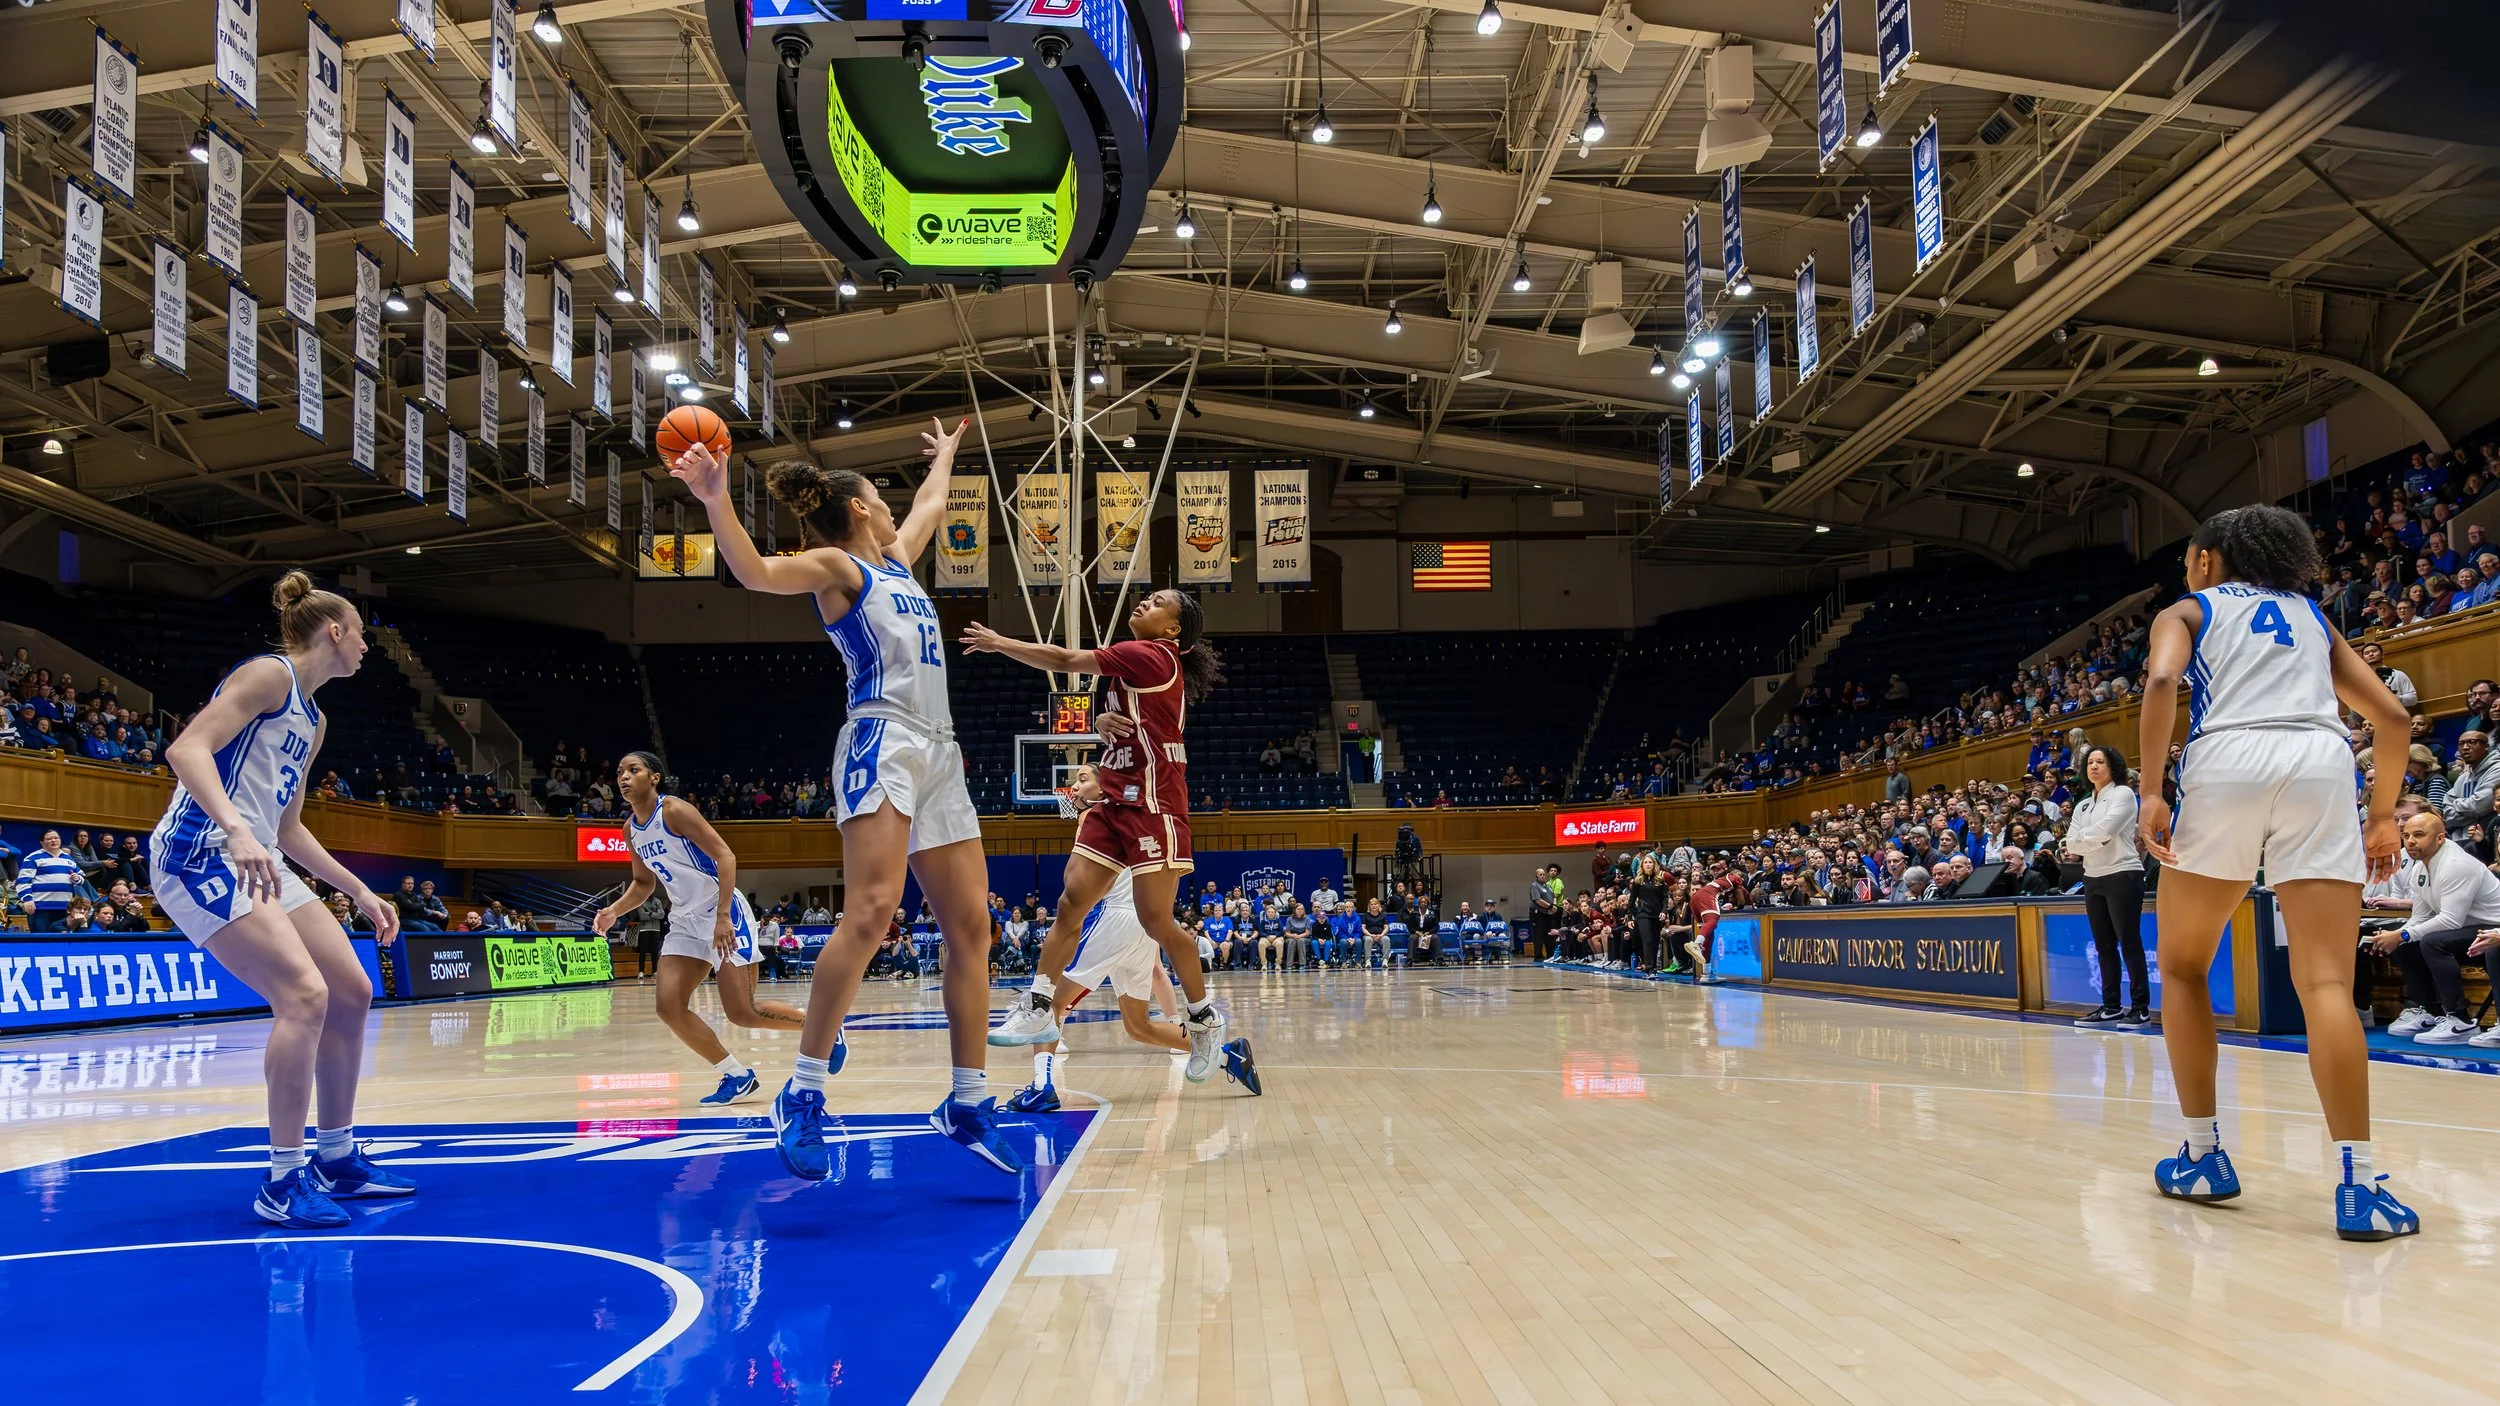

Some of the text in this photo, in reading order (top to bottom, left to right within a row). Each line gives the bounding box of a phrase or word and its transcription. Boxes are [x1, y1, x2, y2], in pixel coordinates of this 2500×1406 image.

[1891, 3, 1906, 27] FOUR
[230, 19, 248, 41] NCAA
[219, 29, 239, 53] FINAL
[229, 69, 247, 90] 1988
[103, 95, 129, 121] ATLANTIC
[318, 97, 335, 117] NCAA
[106, 110, 125, 130] COAST
[97, 115, 134, 150] CONFERENCE
[98, 129, 133, 161] CHAMPIONS
[575, 136, 585, 172] 11
[107, 164, 123, 182] 1964
[214, 183, 237, 205] ATLANTIC
[387, 179, 400, 196] FINAL
[218, 197, 234, 213] COAST
[394, 212, 406, 227] 1990
[947, 217, 1021, 233] wave
[71, 233, 97, 255] ATLANTIC
[956, 235, 1013, 245] rideshare
[76, 247, 93, 263] COAST
[220, 246, 234, 260] 1965
[292, 244, 312, 263] ATLANTIC
[294, 257, 308, 271] COAST
[75, 293, 92, 308] 2010
[160, 290, 182, 308] ATLANTIC
[294, 301, 306, 316] 1966
[165, 345, 178, 360] 2011
[237, 381, 249, 394] 2017
[1025, 488, 1059, 497] NATIONA
[1184, 485, 1222, 494] NATIONAL
[1263, 484, 1301, 493] NATIONAL
[1020, 500, 1067, 509] CHAMPIOS
[1180, 497, 1227, 507] CHAMPIONS
[1259, 496, 1306, 506] CHAMPIONS
[1197, 516, 1223, 527] FINAL
[1278, 516, 1305, 528] FINAL
[1186, 525, 1222, 539] FOUR
[1268, 526, 1303, 542] FOUR
[951, 564, 974, 574] 1991
[1033, 563, 1056, 572] 1992
[1113, 561, 1136, 571] 200
[1194, 561, 1218, 569] 2010
[1273, 559, 1297, 568] 2015
[2251, 600, 2294, 647] 4
[918, 622, 941, 667] 12
[1063, 696, 1089, 709] 7:28
[1058, 710, 1086, 732] 23
[276, 764, 299, 808] 3
[1580, 820, 1636, 835] State Farm
[606, 838, 630, 852] Sta
[651, 861, 673, 882] 3
[1246, 879, 1291, 892] SISTERHD
[433, 950, 463, 960] MARRIOTT
[504, 947, 540, 966] wave
[568, 945, 597, 963] wave
[1777, 937, 1840, 966] CAMERON
[1847, 939, 1906, 970] INDOOR
[1916, 939, 2004, 975] STADIUM
[430, 962, 471, 980] BONVOY
[512, 969, 538, 980] rideshare
[574, 966, 596, 976] rideshare
